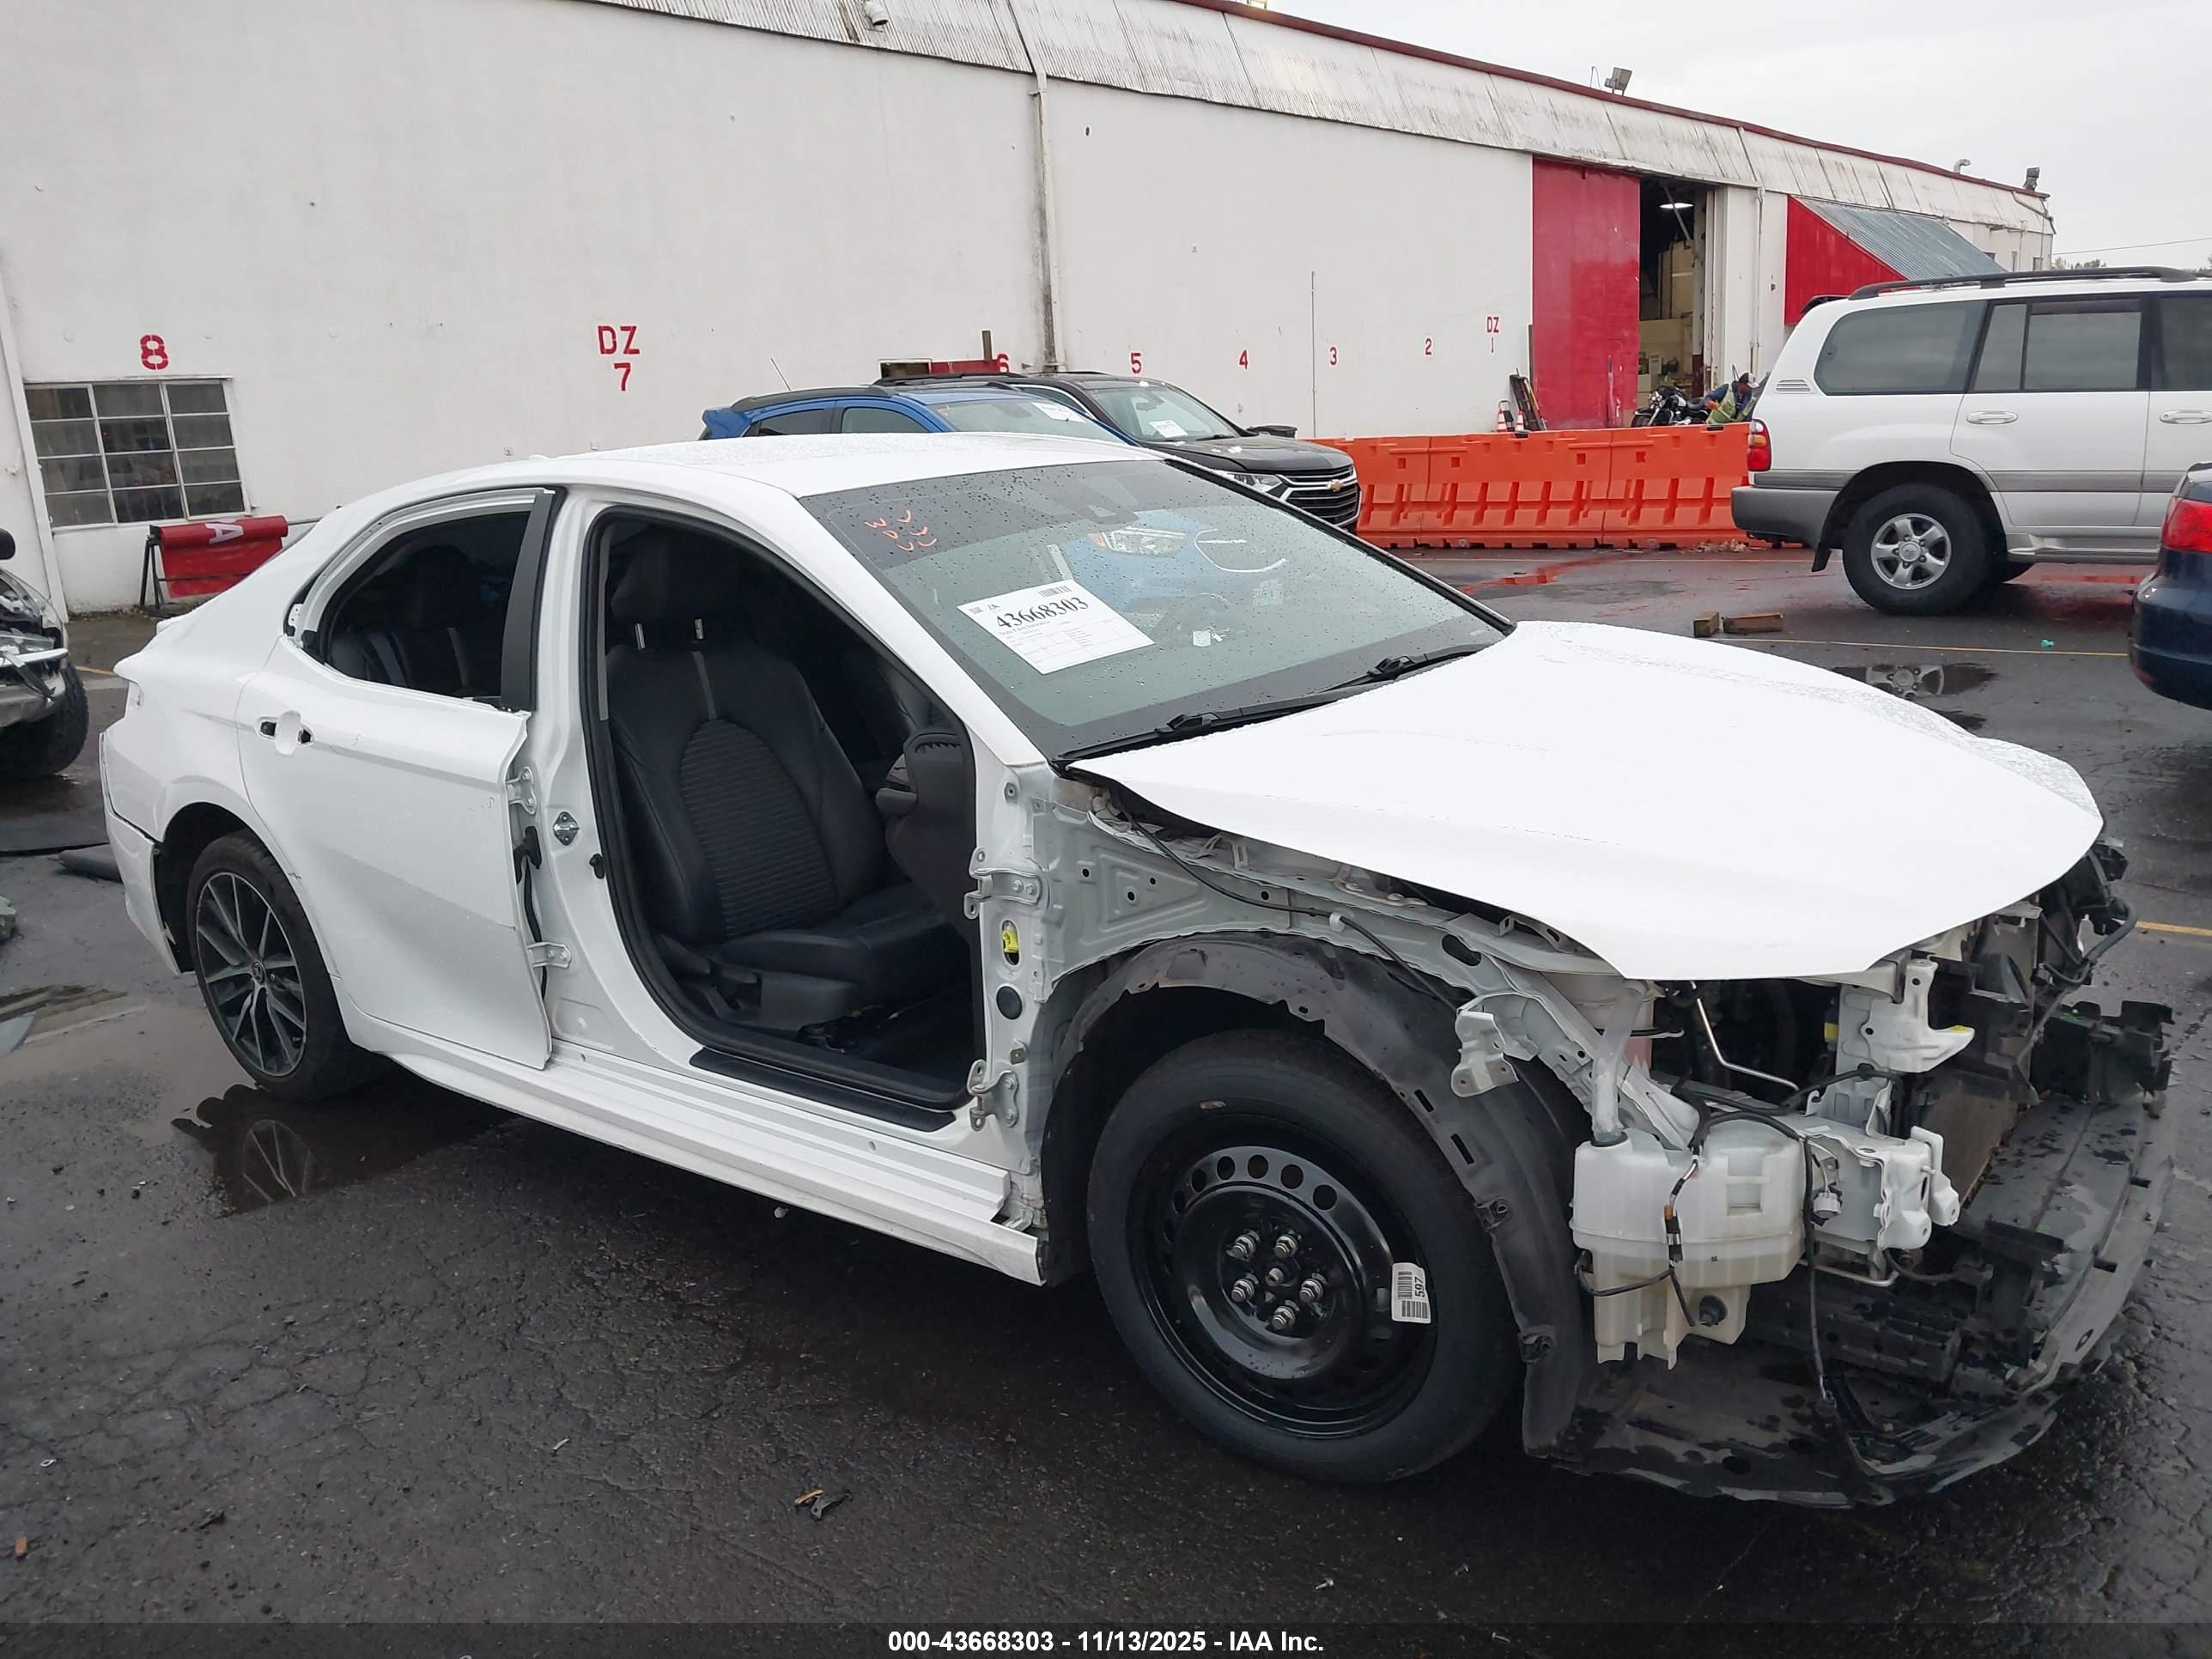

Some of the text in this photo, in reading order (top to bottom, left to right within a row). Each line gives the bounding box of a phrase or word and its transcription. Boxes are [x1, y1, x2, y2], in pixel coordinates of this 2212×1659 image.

[1486, 315, 1499, 333] DZ
[598, 325, 640, 356] DZ
[1425, 337, 1432, 356] 2
[140, 334, 169, 371] 8
[1130, 352, 1142, 374] 5
[1239, 350, 1248, 368] 4
[1330, 346, 1338, 366] 3
[613, 362, 632, 392] 7
[996, 596, 1090, 629] 43668303
[1415, 1277, 1425, 1297] 597
